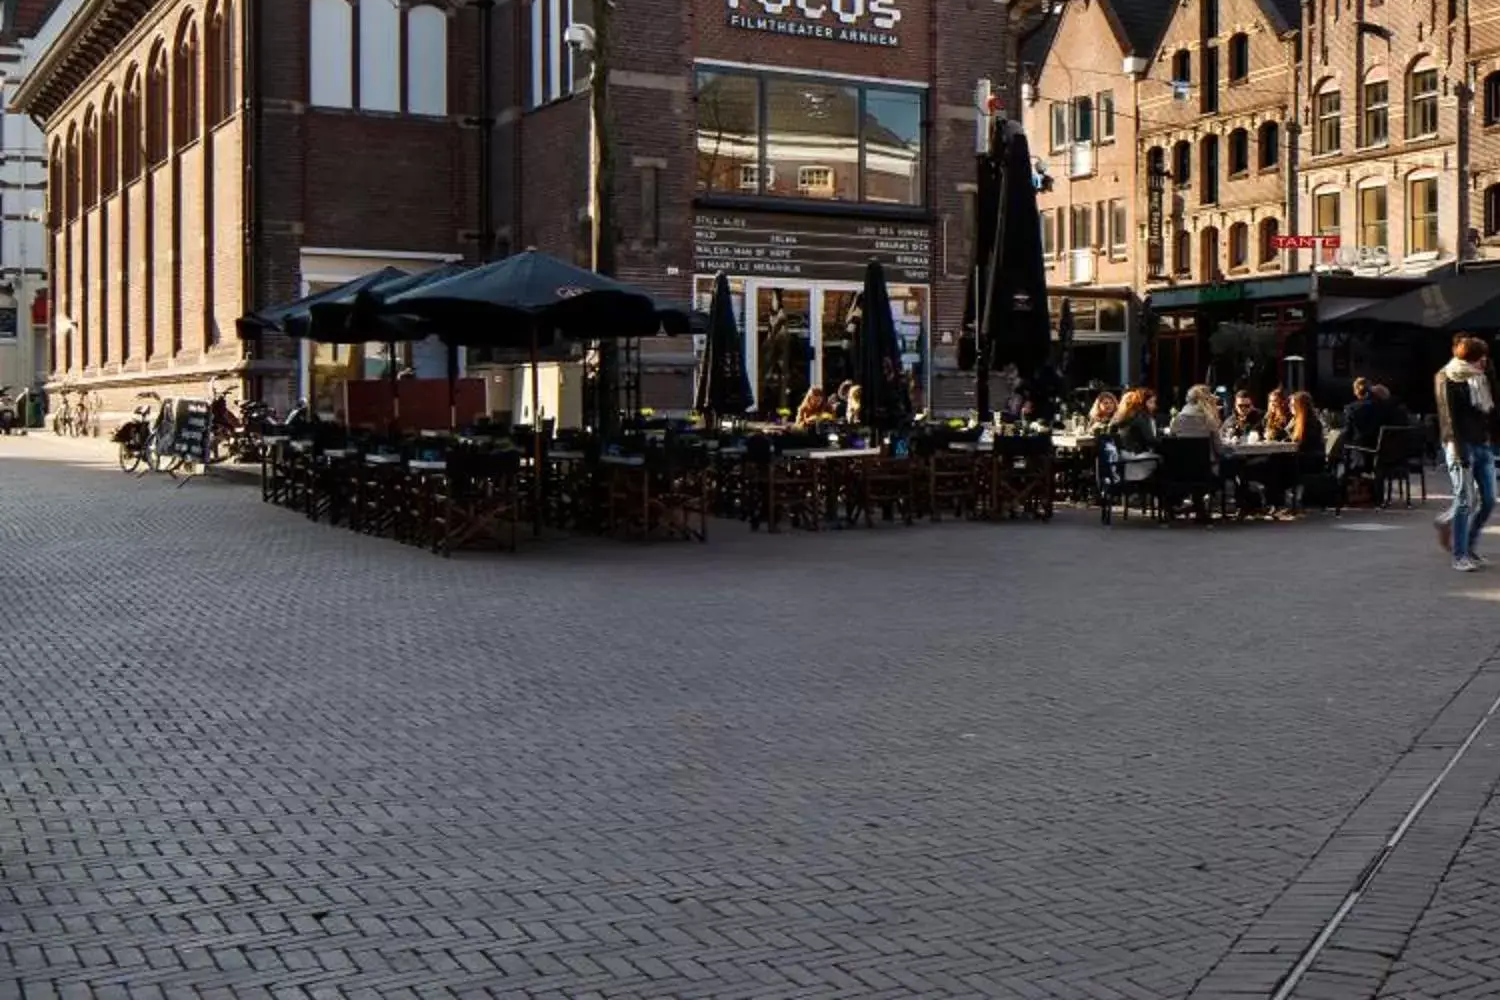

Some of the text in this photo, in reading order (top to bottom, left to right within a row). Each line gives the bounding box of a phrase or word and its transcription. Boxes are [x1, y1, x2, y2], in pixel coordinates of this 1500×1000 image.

[730, 14, 899, 46] FILMTHEATER ARNHEM
[1276, 237, 1337, 248] TANTE
